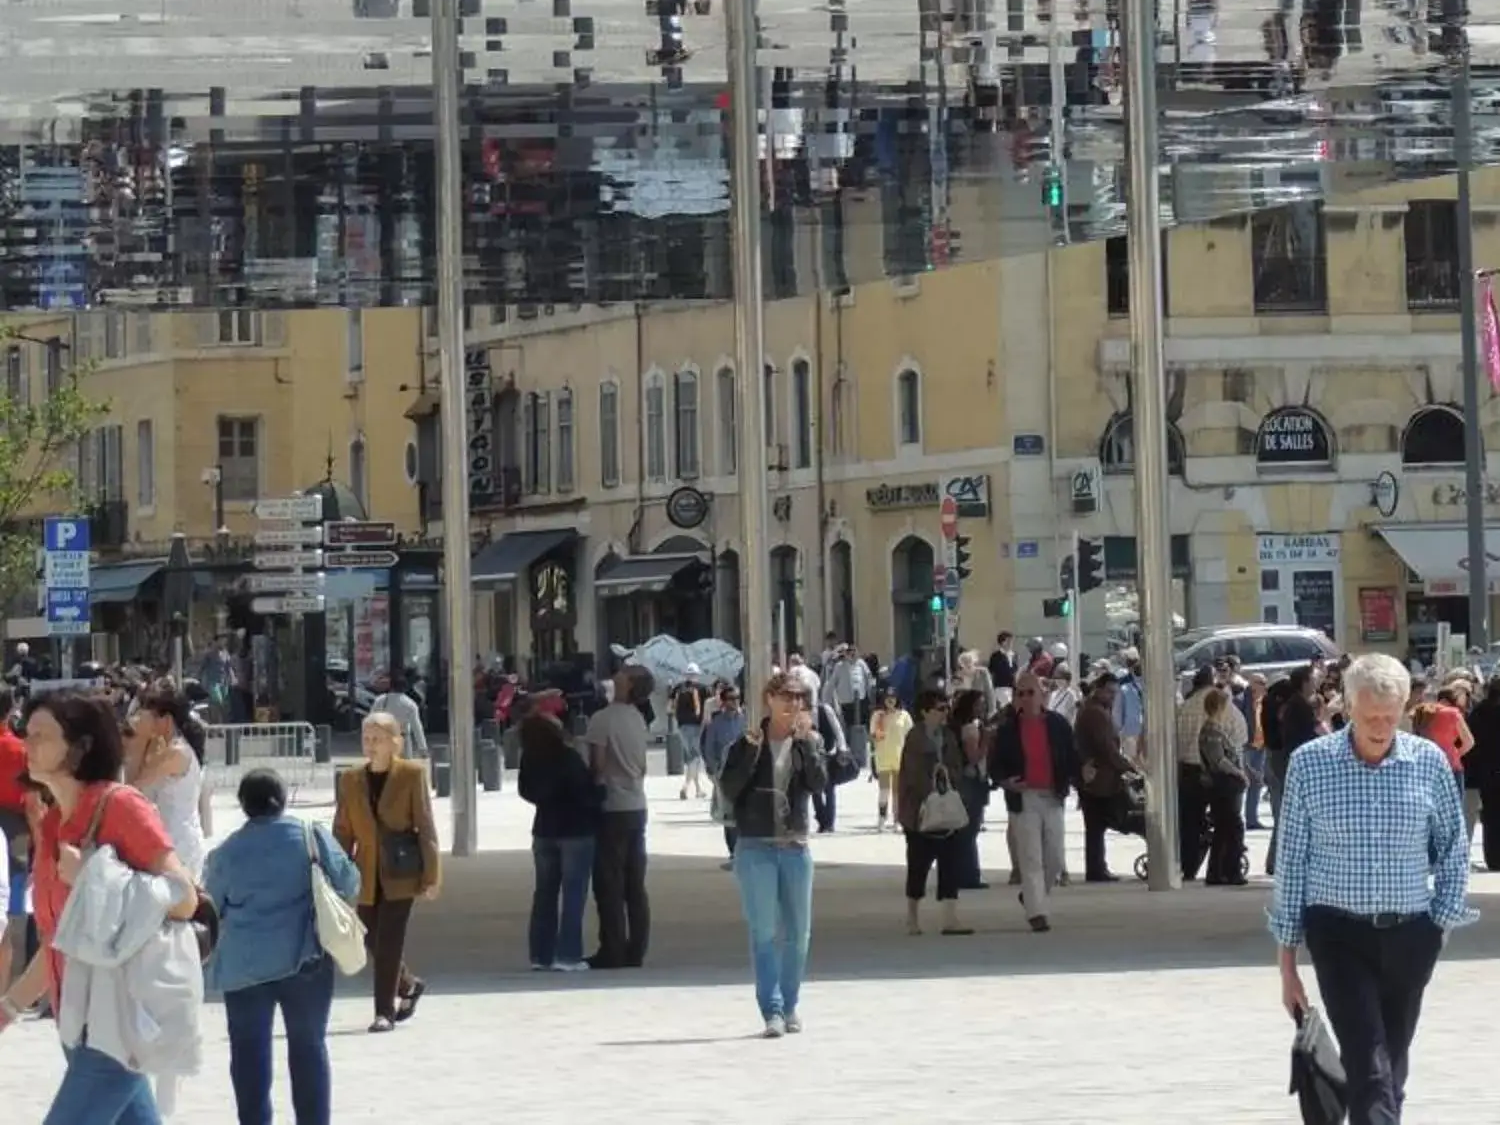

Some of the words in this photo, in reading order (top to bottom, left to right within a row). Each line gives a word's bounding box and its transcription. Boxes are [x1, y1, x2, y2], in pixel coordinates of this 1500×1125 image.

[1263, 416, 1313, 432] LOCATION
[1265, 434, 1276, 450] DE
[1279, 434, 1314, 450] SALLES
[57, 523, 77, 548] P
